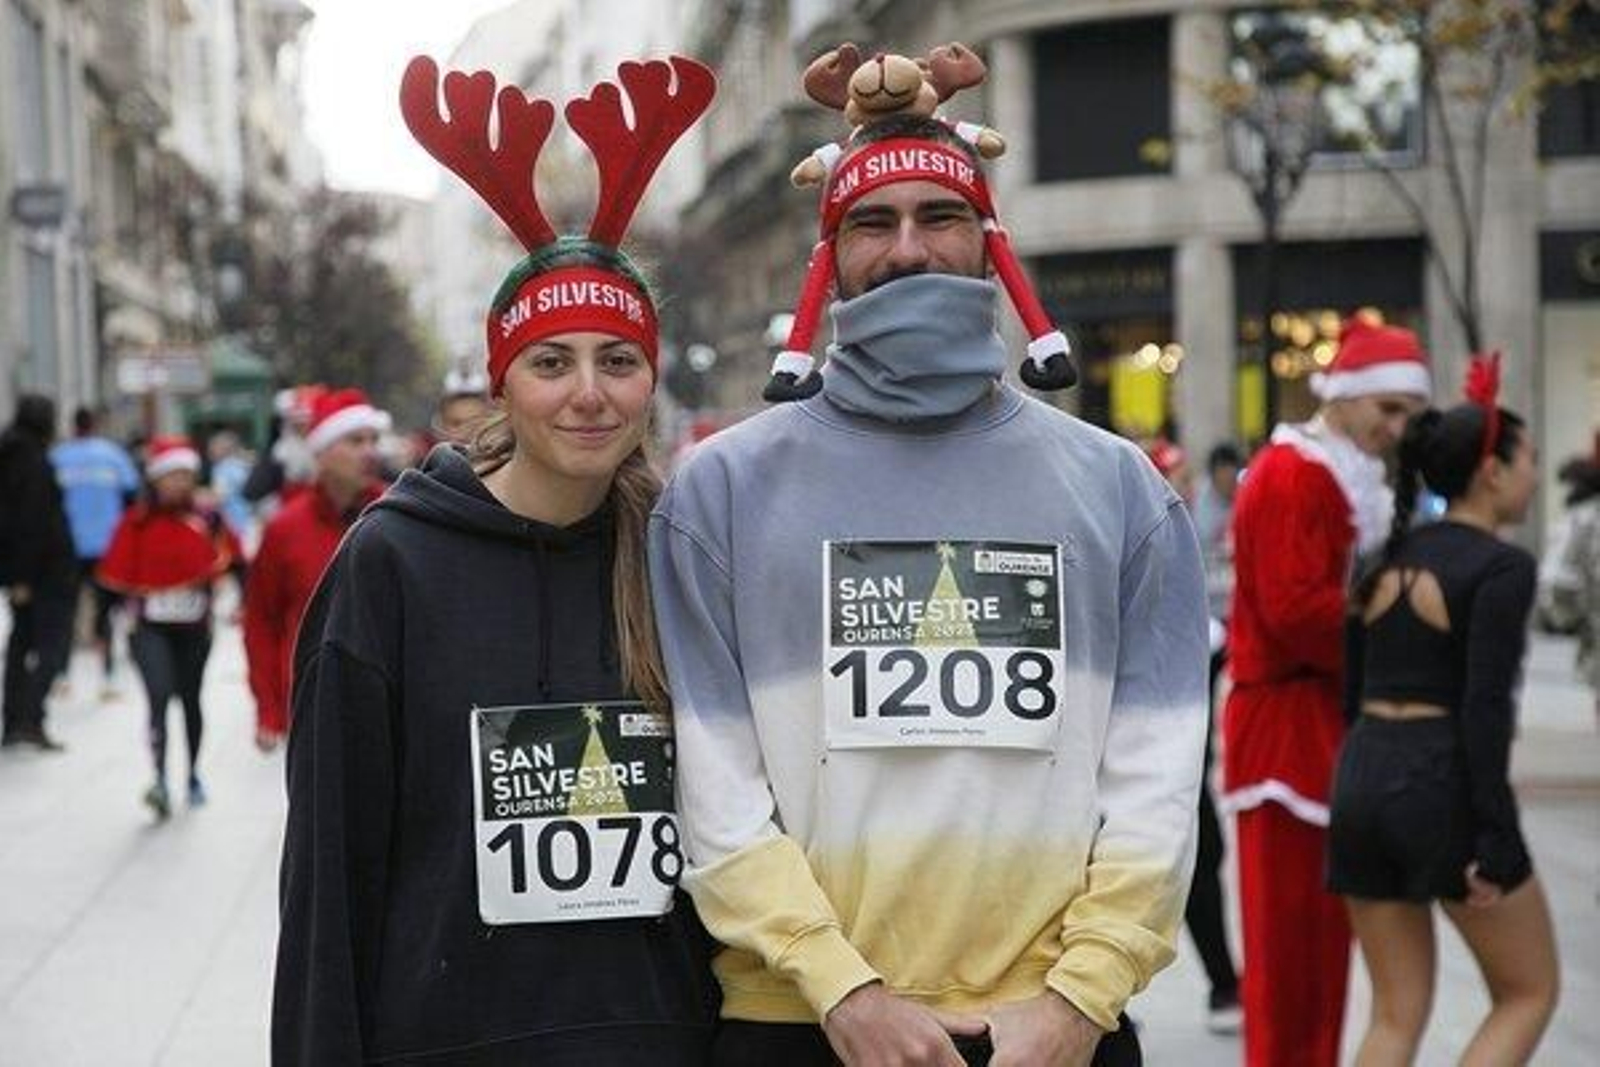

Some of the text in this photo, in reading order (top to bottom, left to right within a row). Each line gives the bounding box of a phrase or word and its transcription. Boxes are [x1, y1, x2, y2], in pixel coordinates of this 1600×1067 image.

[501, 295, 532, 339] SAN
[839, 576, 904, 600] SAN
[841, 597, 1001, 627] SILVESTRE
[829, 649, 1057, 721] 1208
[489, 742, 555, 774] SAN
[492, 761, 648, 801] SILVESTRE
[486, 814, 685, 894] 1078
